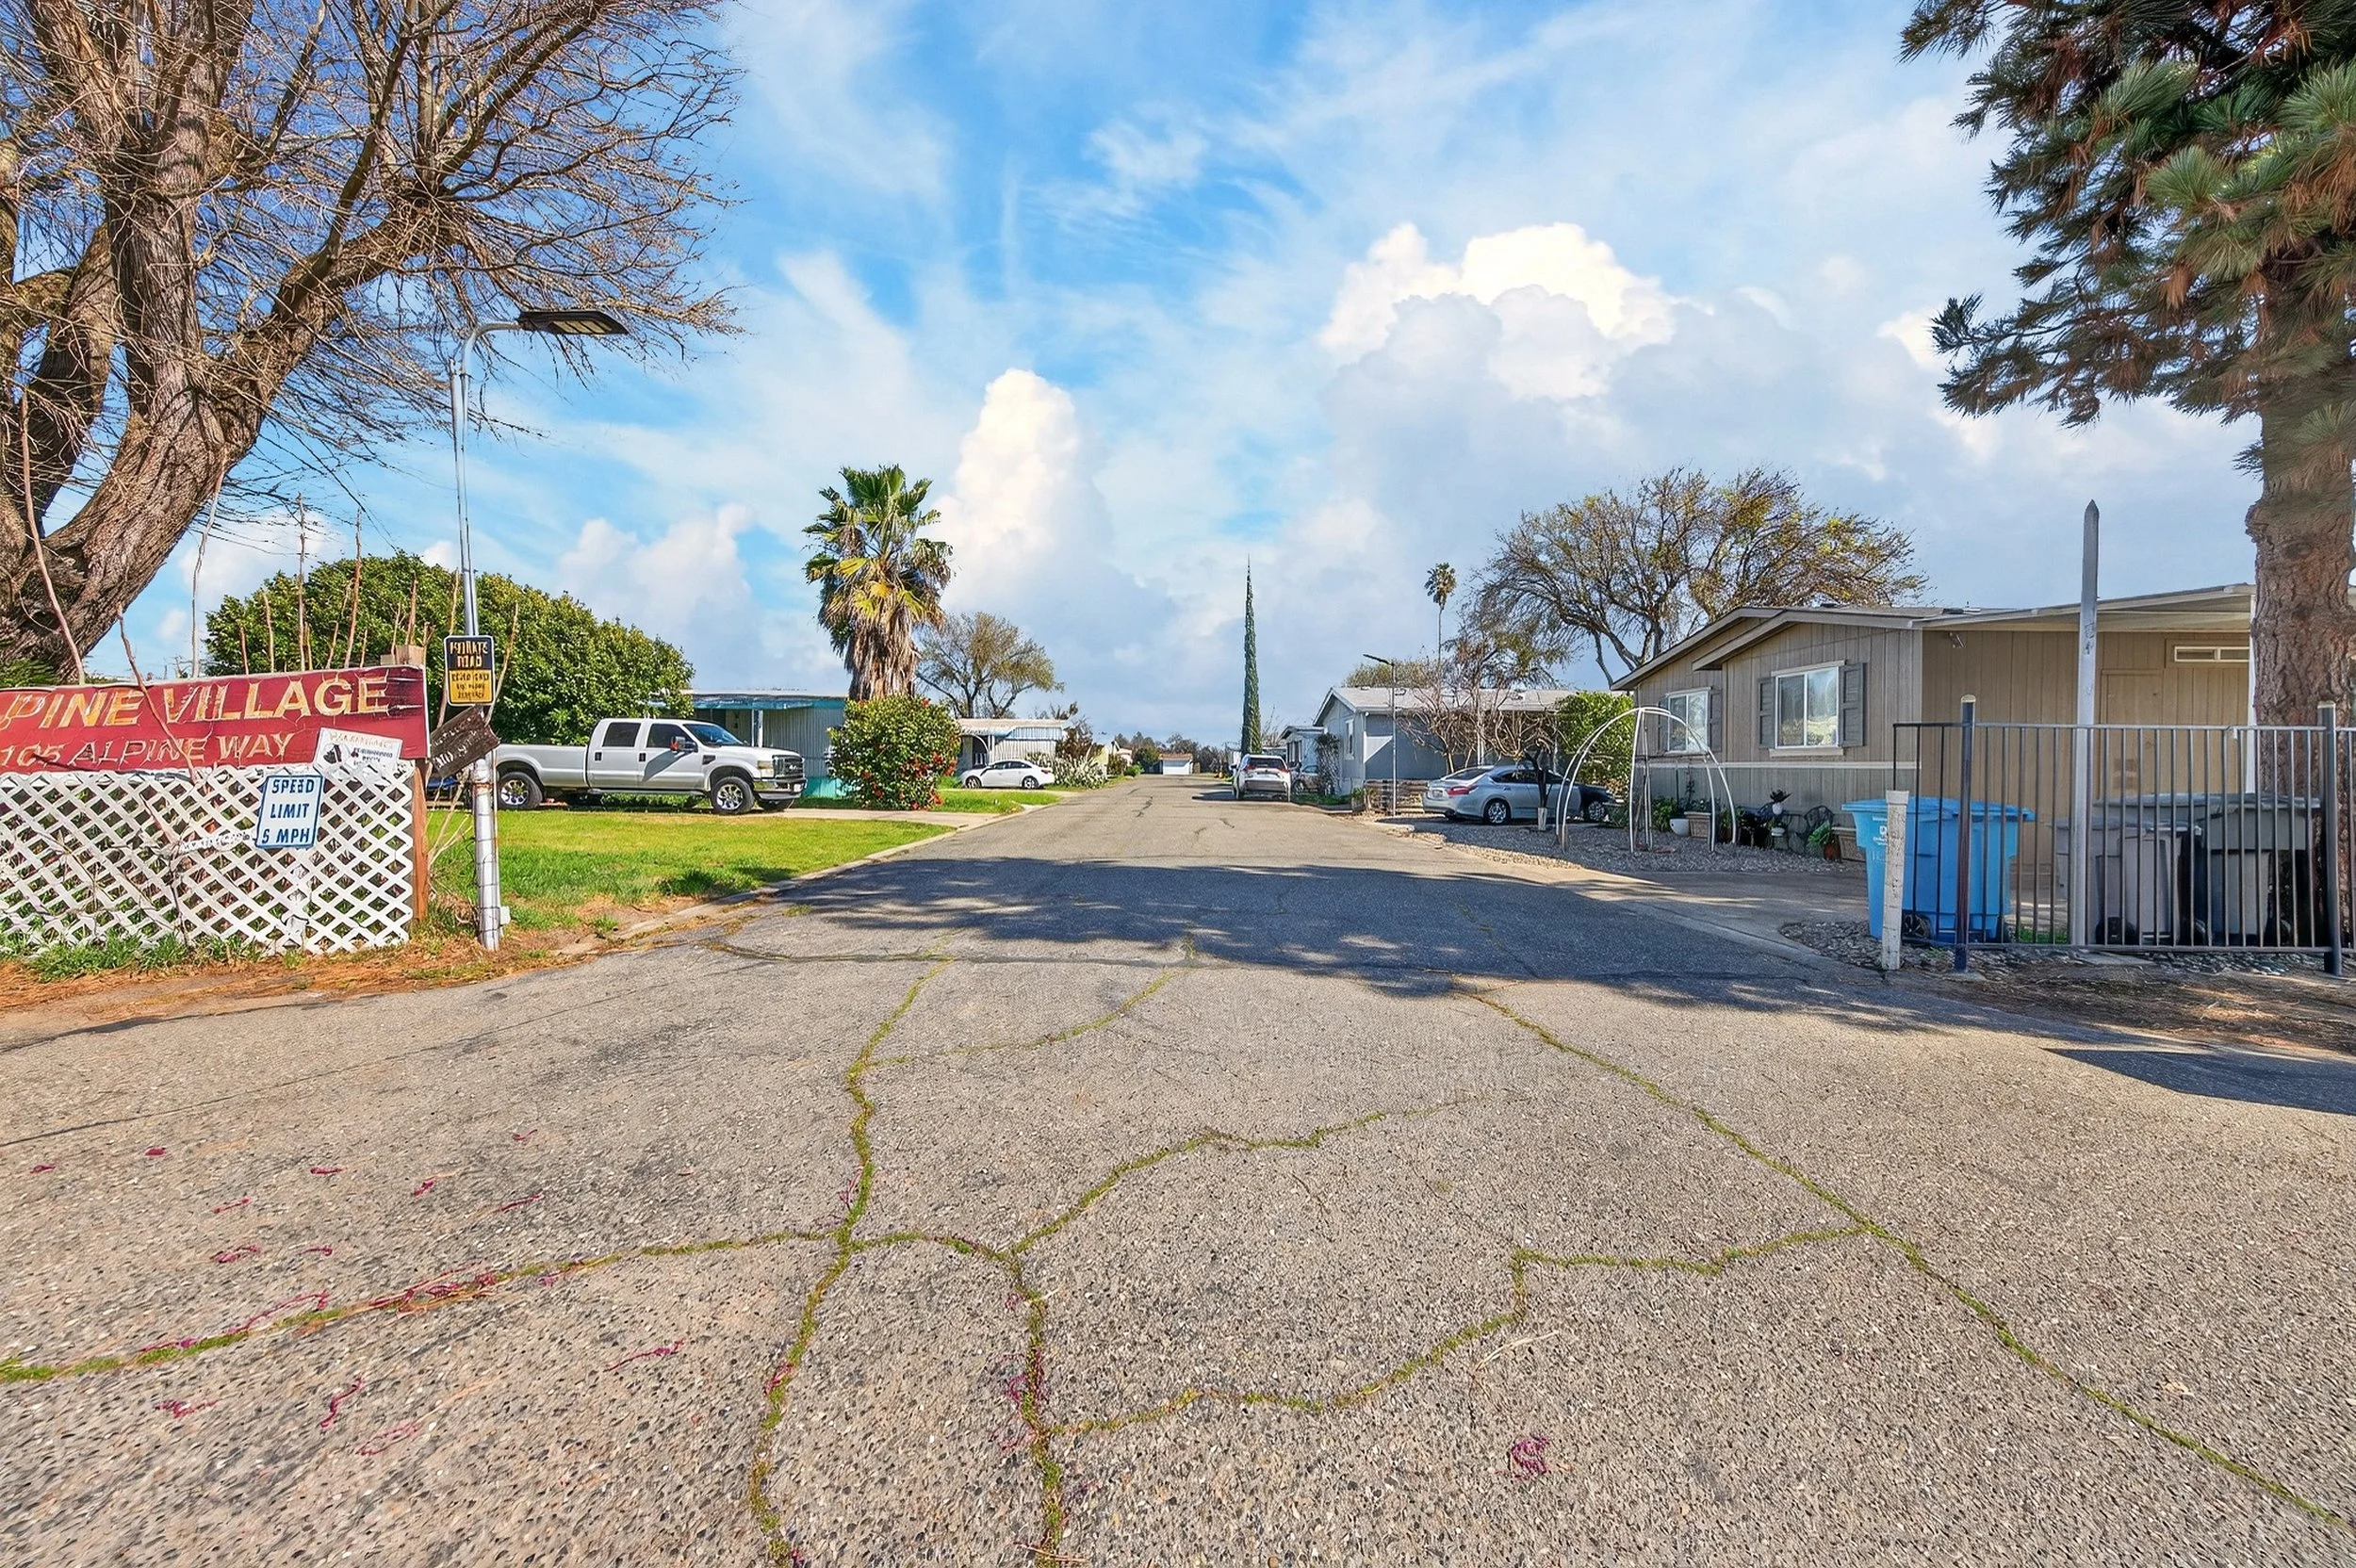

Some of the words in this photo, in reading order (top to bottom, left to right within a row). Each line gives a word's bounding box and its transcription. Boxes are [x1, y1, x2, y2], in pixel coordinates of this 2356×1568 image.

[163, 672, 389, 725] VILLAGE
[67, 737, 208, 768] ALPINE
[216, 732, 295, 760] WAY
[271, 778, 315, 794] SPEED
[270, 803, 310, 819] LIMIT
[276, 827, 311, 844] MPH
